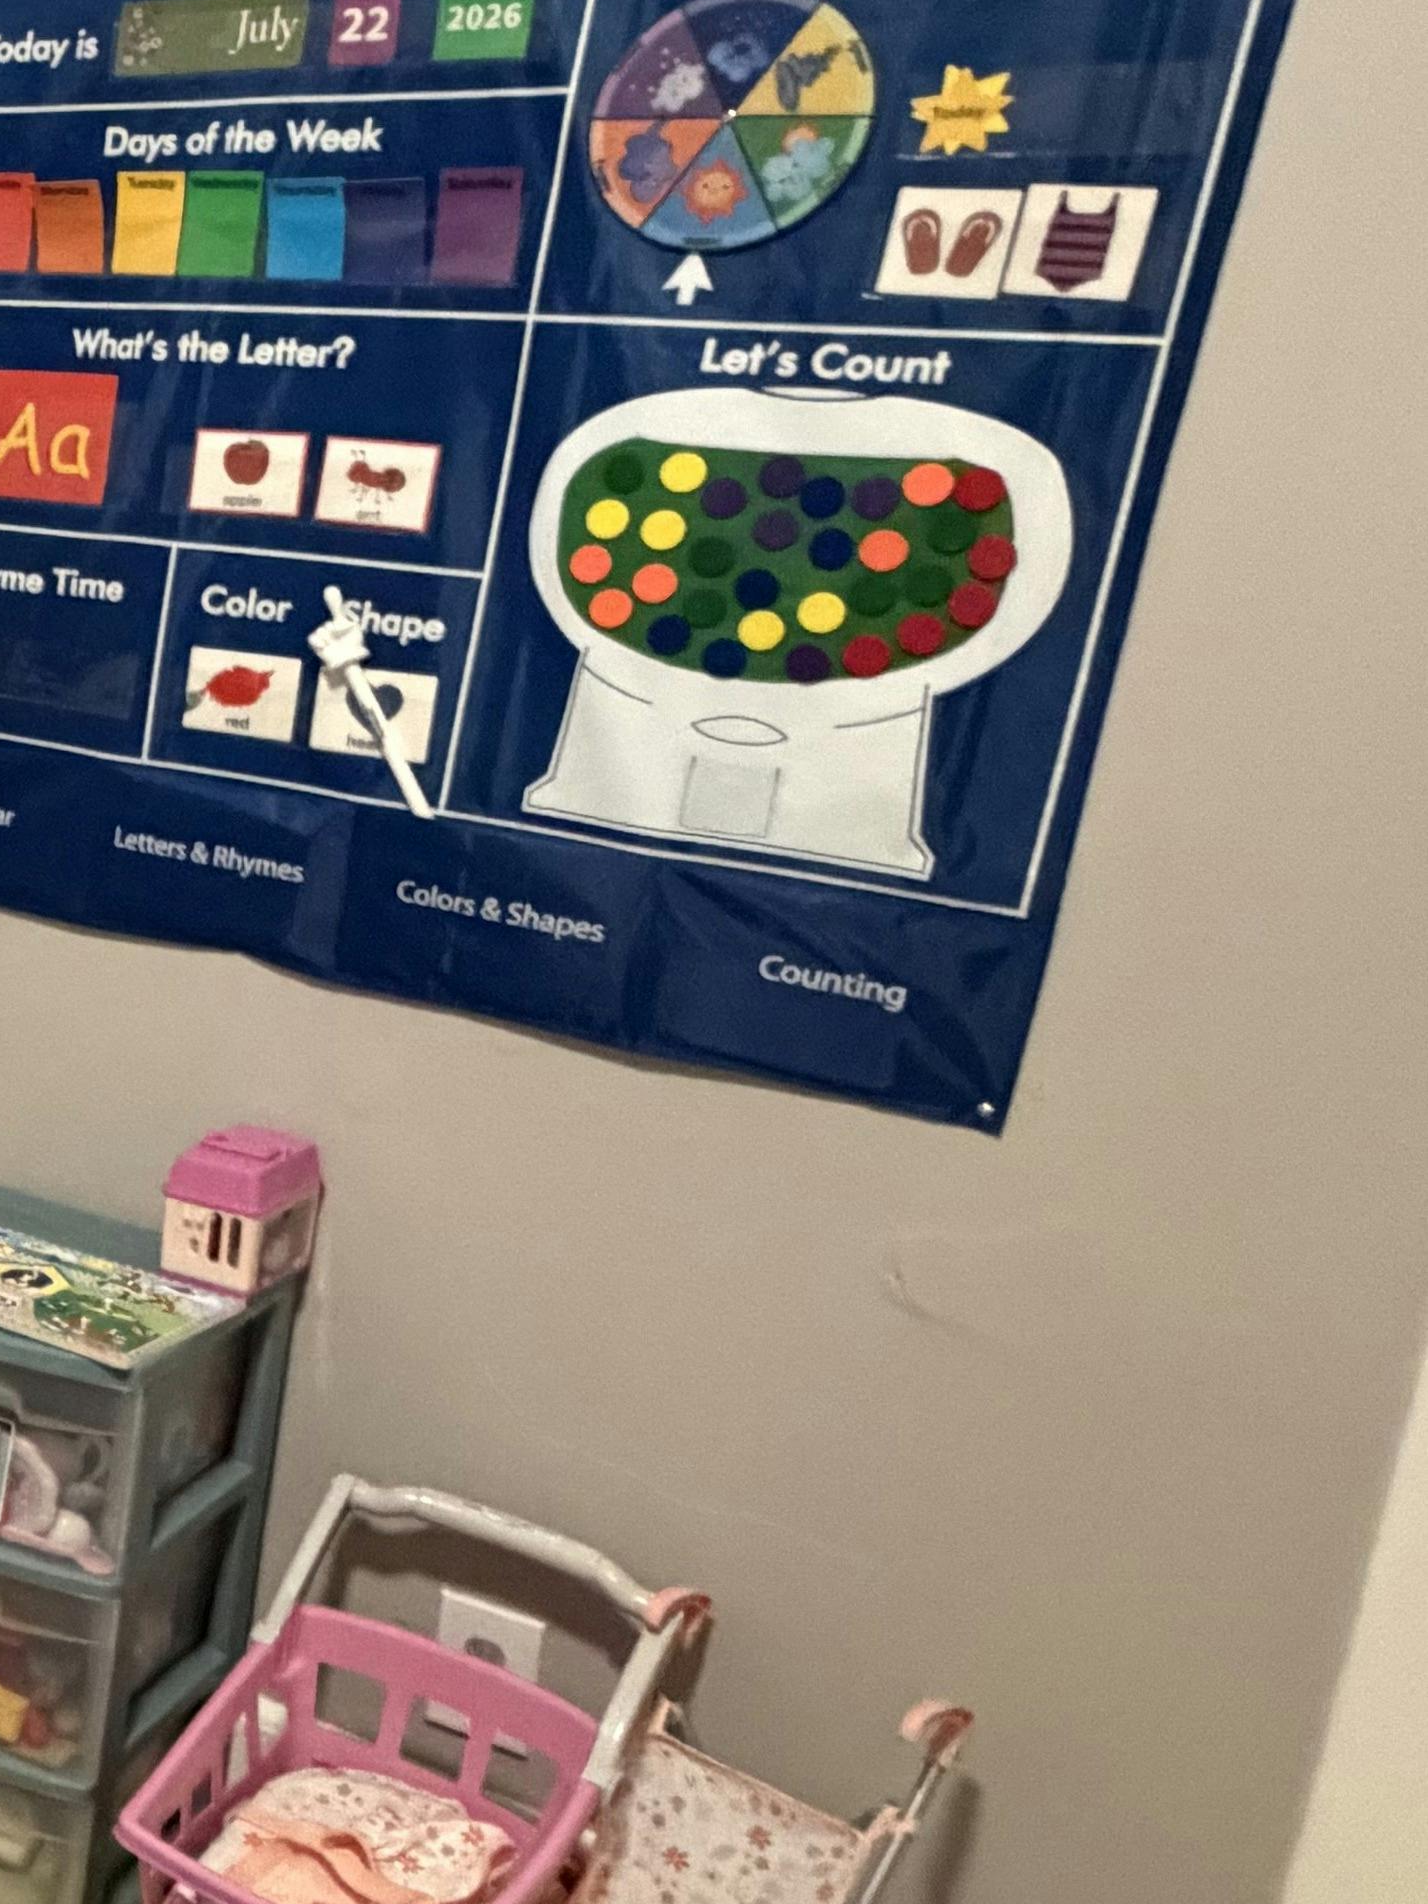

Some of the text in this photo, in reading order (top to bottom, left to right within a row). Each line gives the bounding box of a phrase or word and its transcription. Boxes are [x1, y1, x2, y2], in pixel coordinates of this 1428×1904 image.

[228, 5, 300, 54] July
[339, 5, 390, 43] 22
[446, 1, 523, 32] 2026
[74, 29, 99, 60] is
[103, 117, 383, 163] Days of the Week
[72, 328, 356, 370] What's the Letter?
[700, 337, 952, 387] Let's Count
[54, 568, 125, 602] Time
[200, 584, 294, 623] Color
[114, 825, 305, 885] Letters & Rhymes
[396, 879, 606, 944] Colors & Shapes
[758, 954, 908, 1013] Counting
